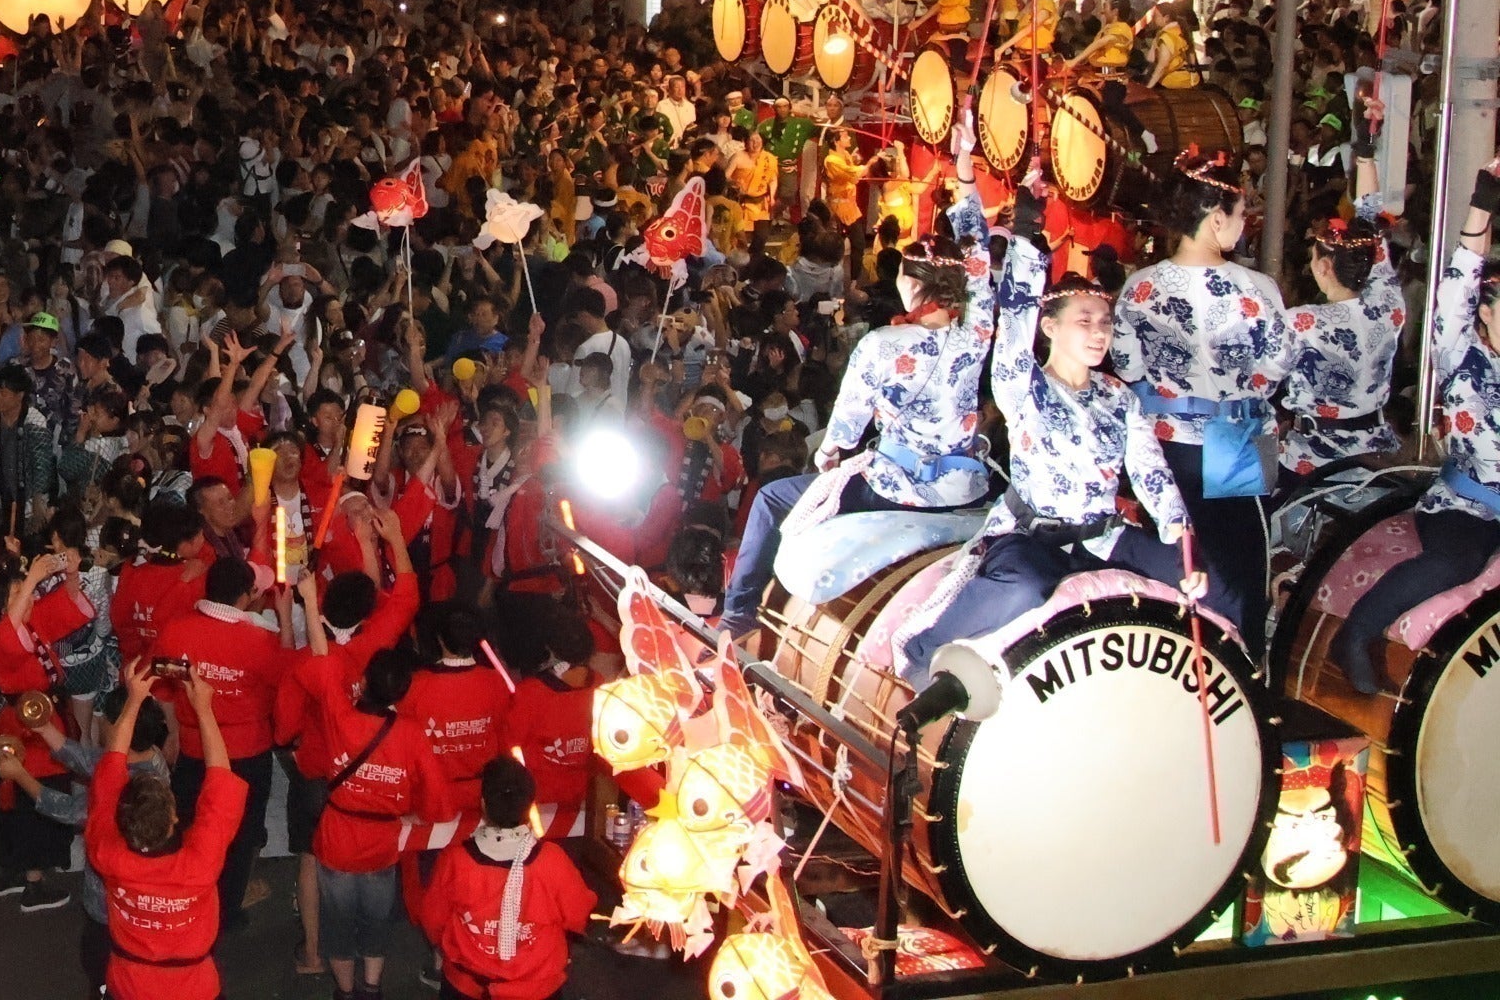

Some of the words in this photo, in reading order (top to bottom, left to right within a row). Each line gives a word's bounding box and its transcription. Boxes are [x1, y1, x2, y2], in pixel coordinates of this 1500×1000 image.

[1026, 632, 1244, 726] MITSUBISHI
[445, 726, 486, 738] ELECTRIC
[355, 769, 400, 784] ELECTRIC
[137, 901, 190, 913] ELECTRIC
